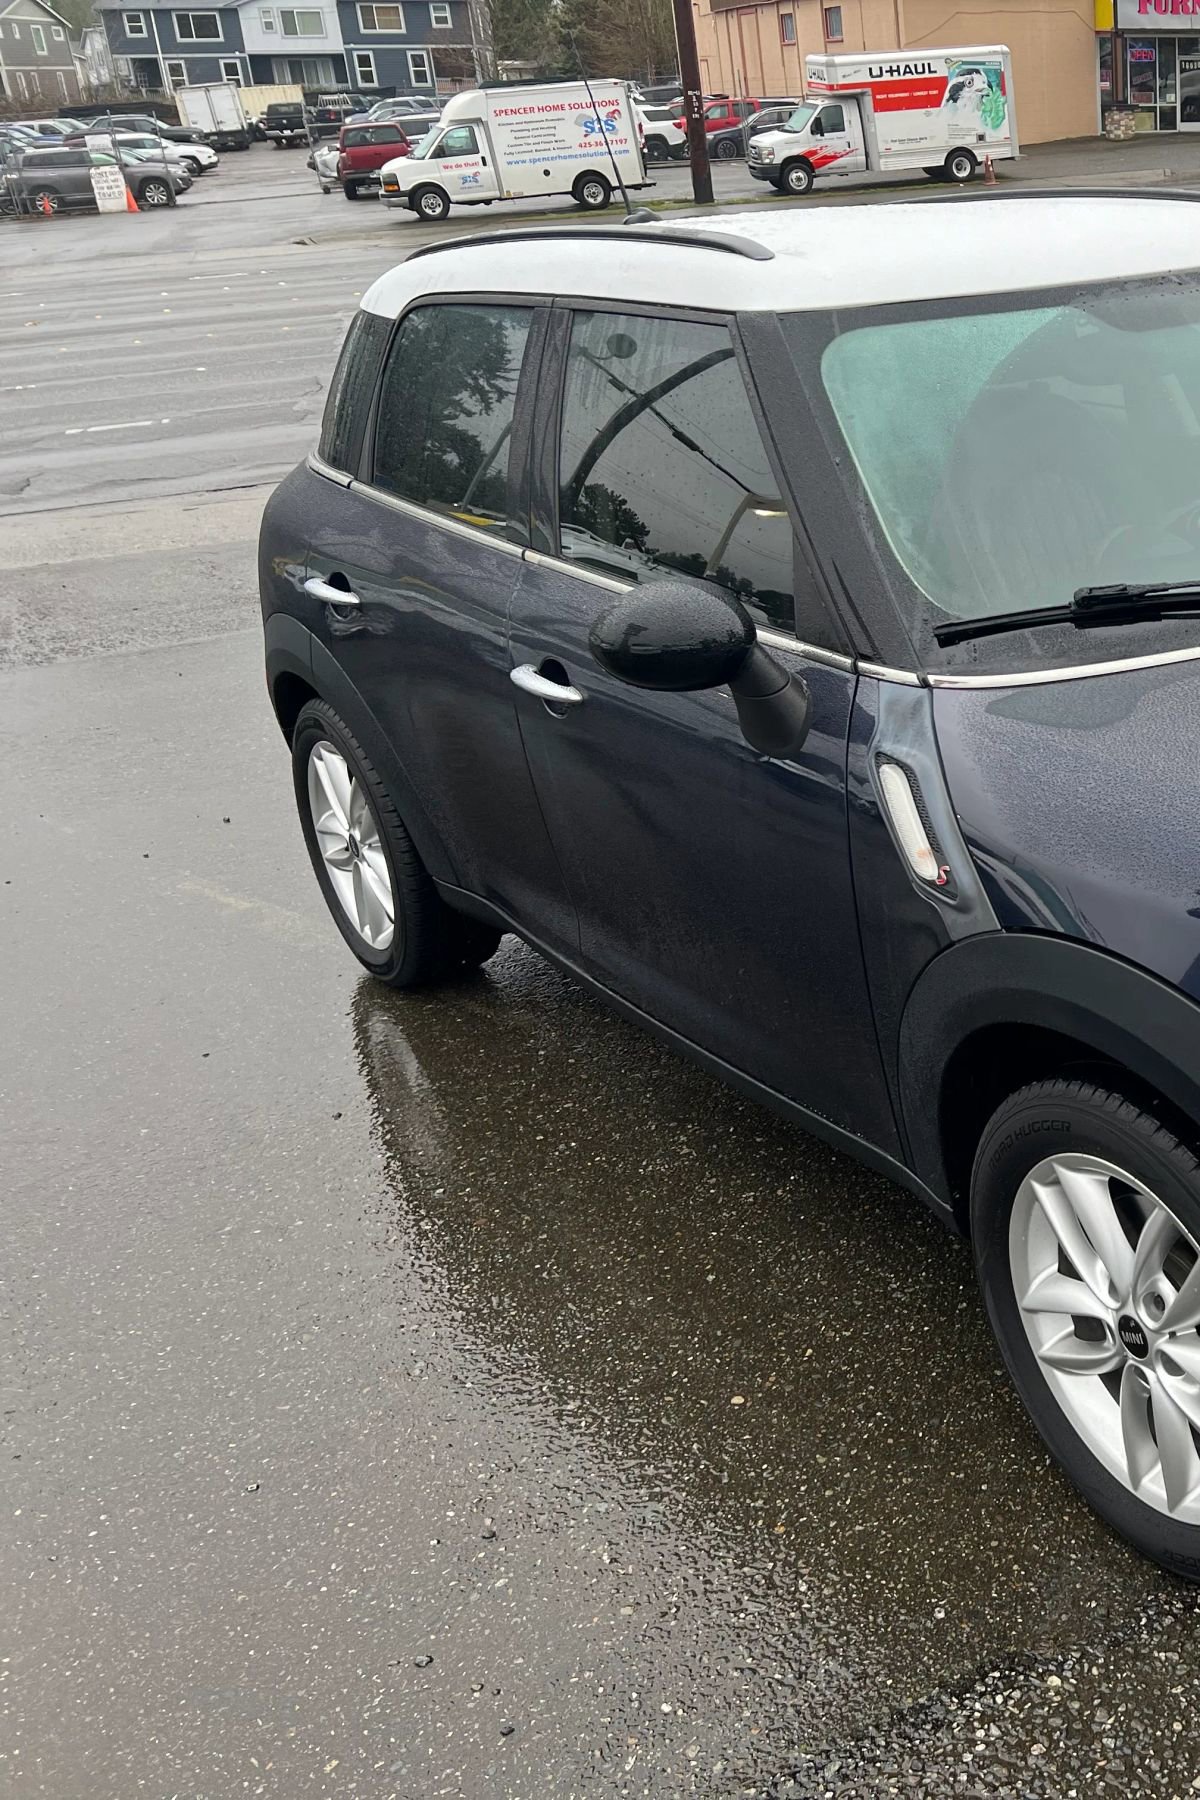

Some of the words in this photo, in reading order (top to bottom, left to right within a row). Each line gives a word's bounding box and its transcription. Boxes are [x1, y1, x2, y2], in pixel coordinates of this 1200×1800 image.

[808, 67, 826, 81] U-HAUL
[868, 62, 938, 79] U-HAUL
[493, 106, 535, 117] SPENCER
[537, 104, 566, 113] HOME
[506, 149, 630, 166] www.spencerhomesolution.com
[1014, 1119, 1072, 1140] HUGGER
[1121, 1330, 1144, 1345] MINI
